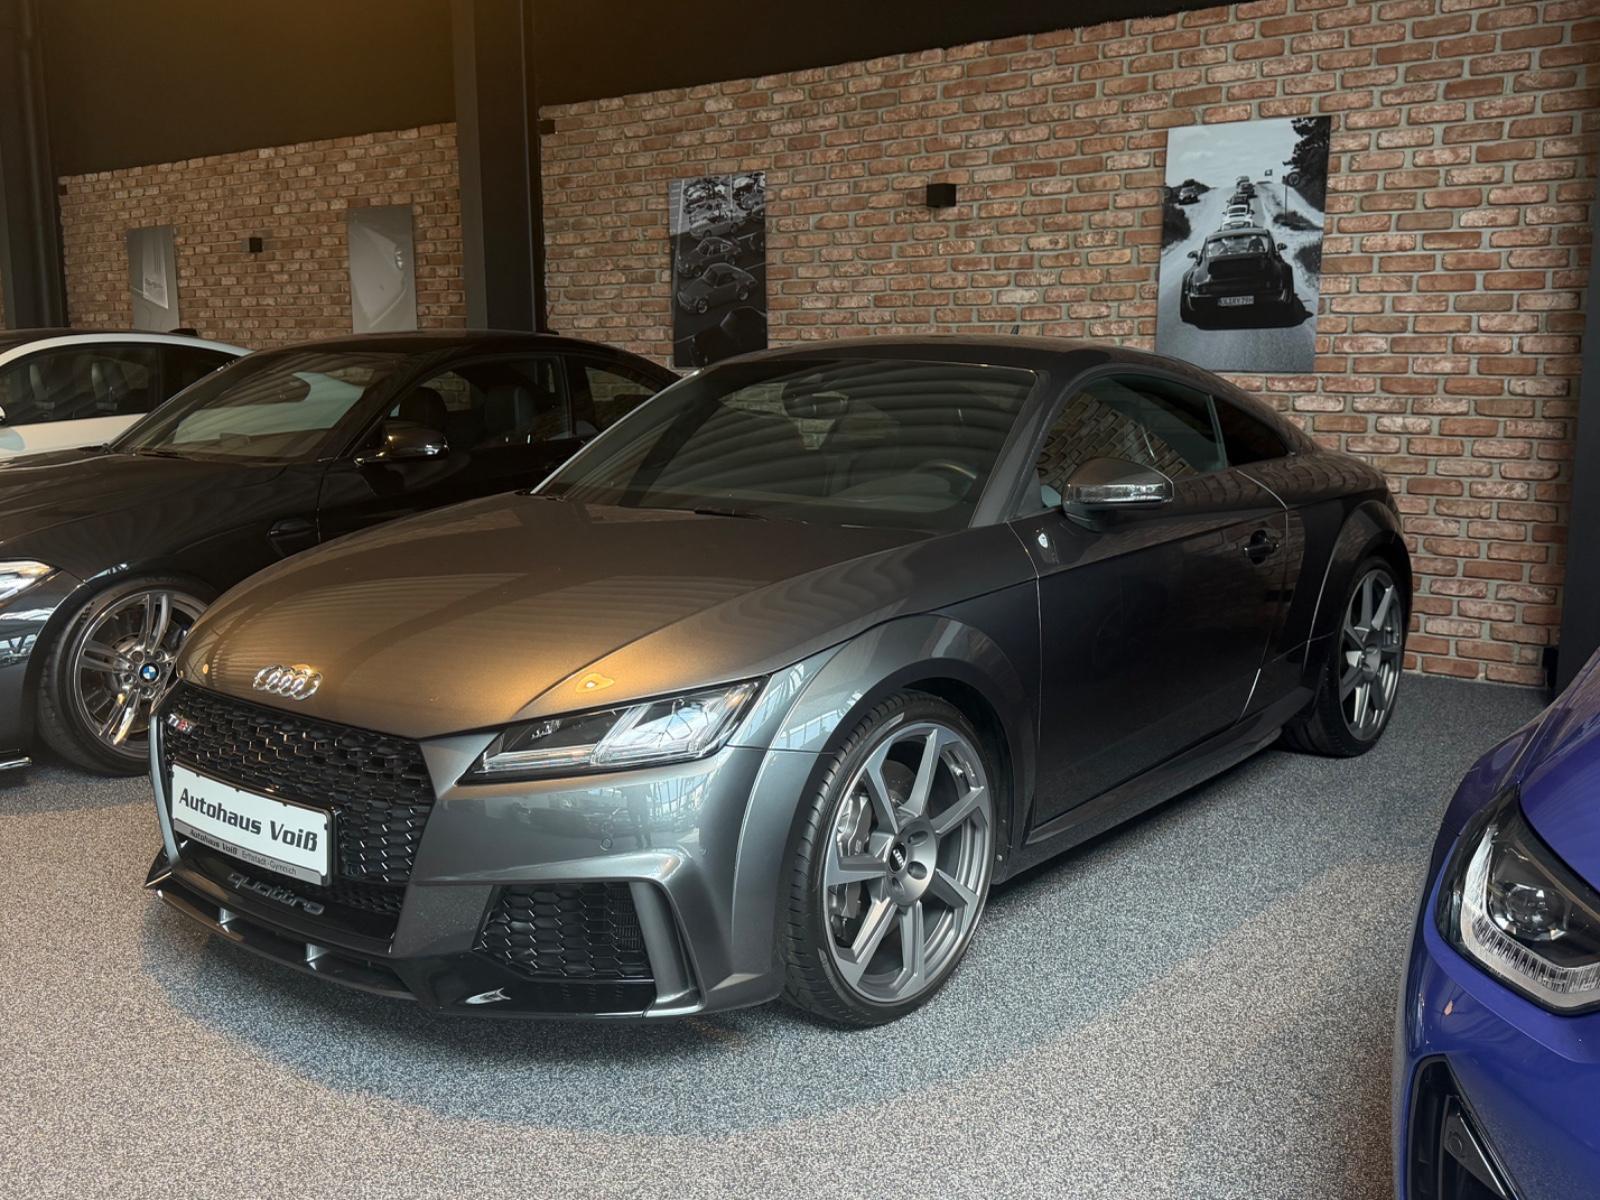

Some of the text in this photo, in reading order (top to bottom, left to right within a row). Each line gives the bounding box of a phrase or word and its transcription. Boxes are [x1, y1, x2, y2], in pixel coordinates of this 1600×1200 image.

[178, 787, 318, 852] Autohaus Voiß
[190, 829, 220, 848] Autohaus
[227, 872, 325, 915] quattro
